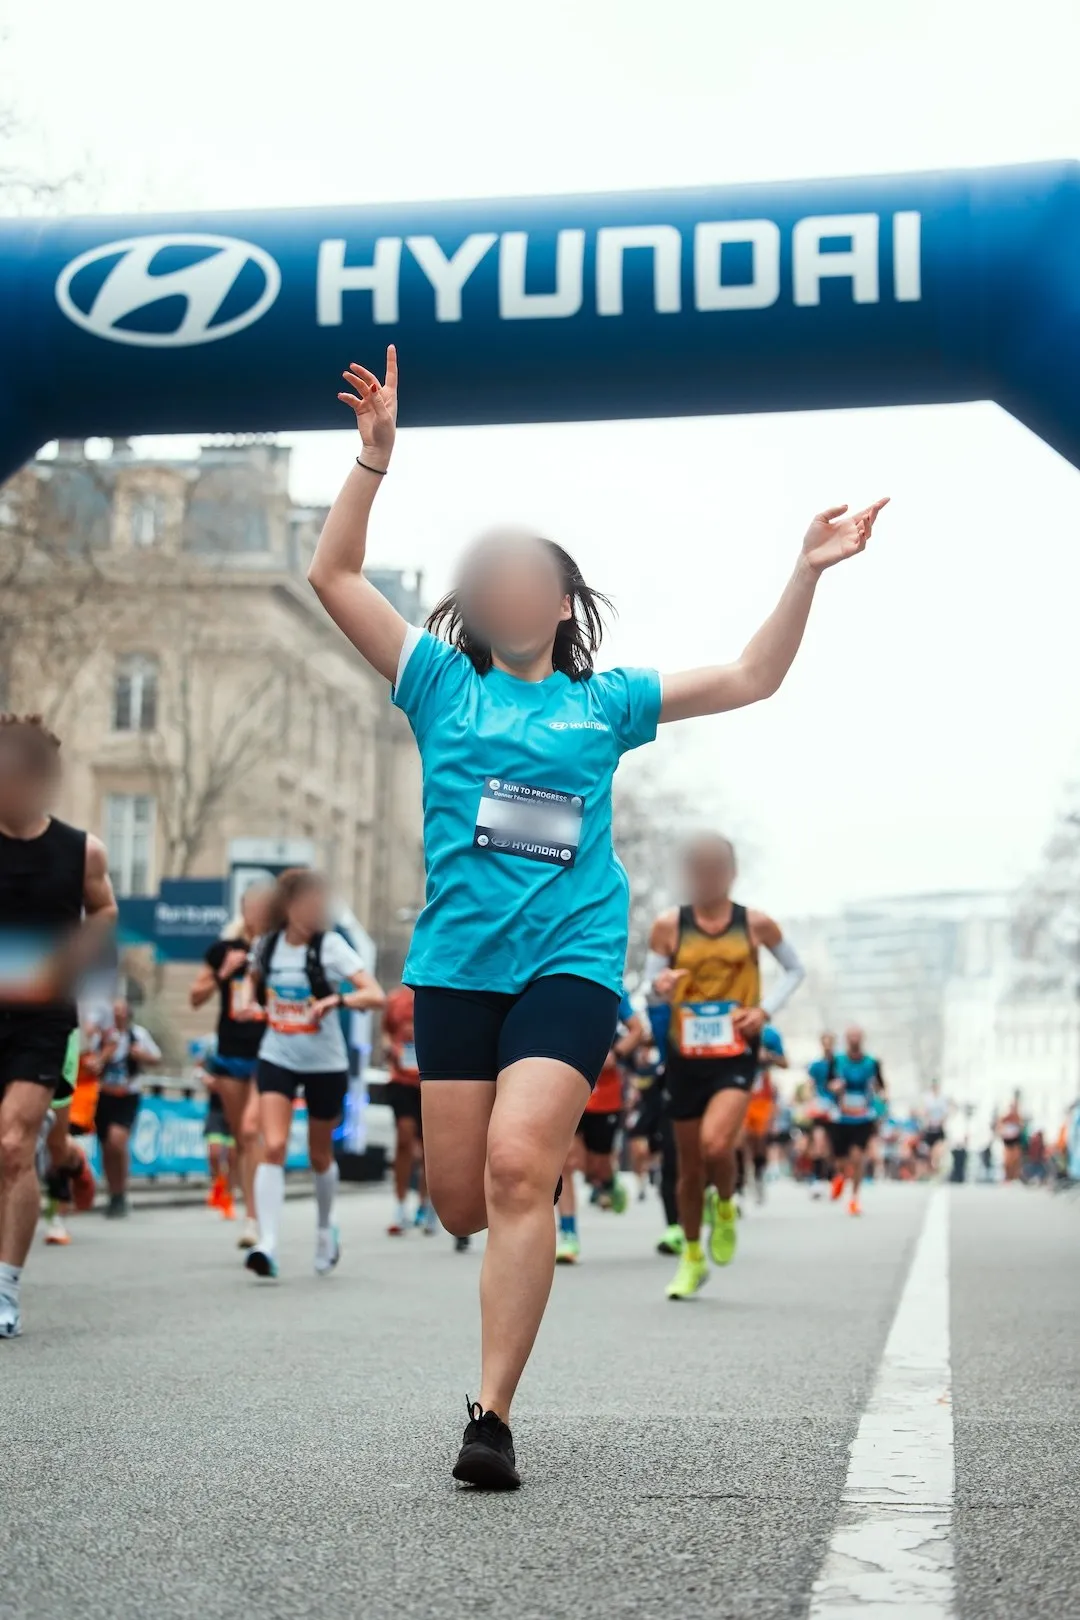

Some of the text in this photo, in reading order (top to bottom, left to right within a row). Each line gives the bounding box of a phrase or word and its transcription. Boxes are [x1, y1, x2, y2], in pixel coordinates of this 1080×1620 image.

[316, 211, 921, 327] HYUNDAI
[493, 790, 514, 799] Donner
[503, 783, 568, 803] RUN TO PROGRESS
[512, 841, 560, 858] HYUNDAI
